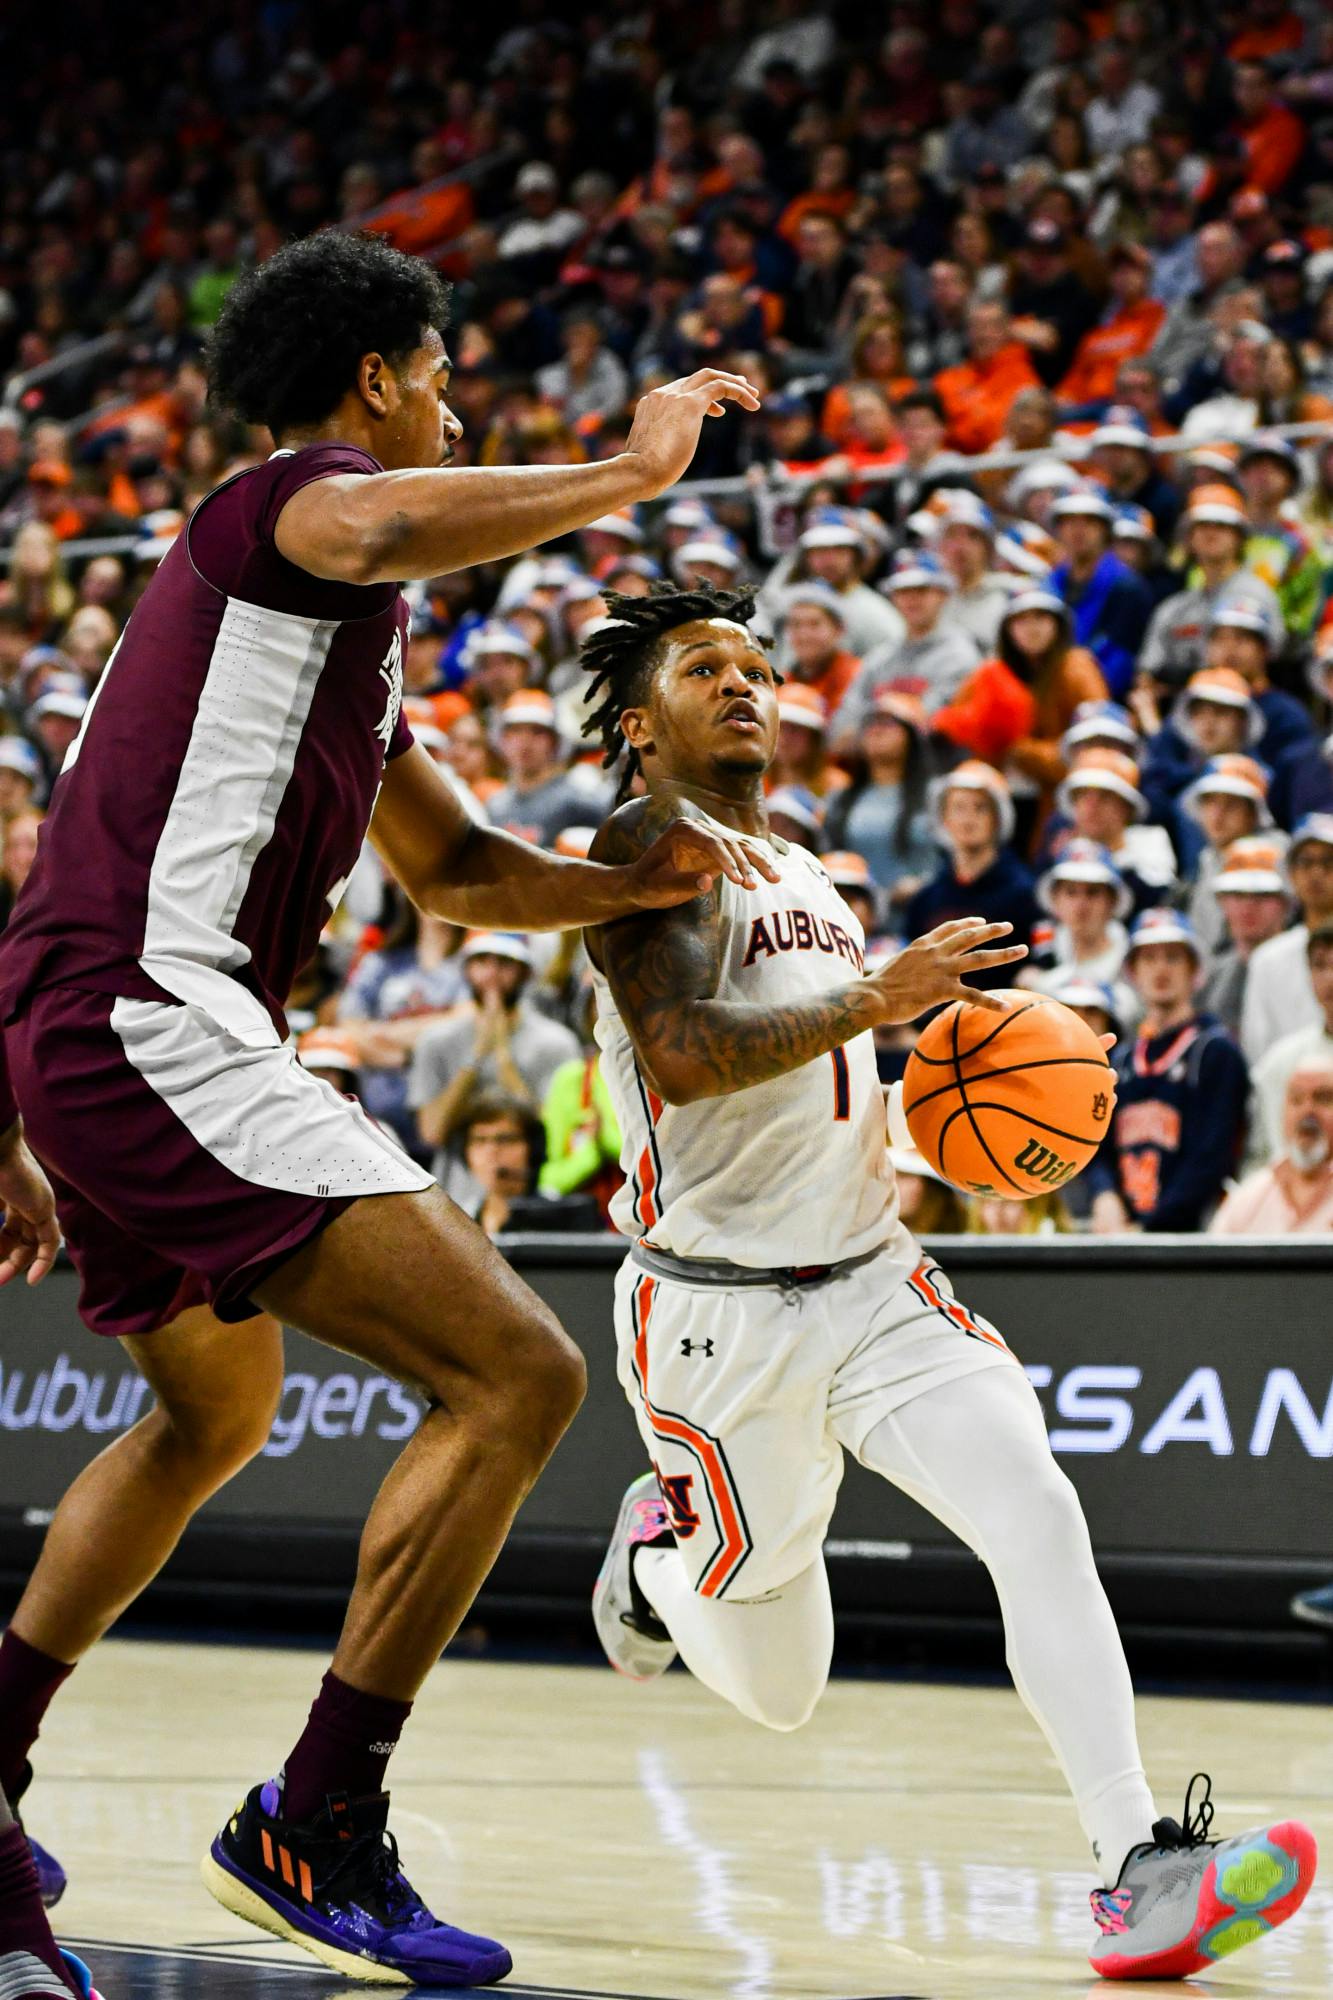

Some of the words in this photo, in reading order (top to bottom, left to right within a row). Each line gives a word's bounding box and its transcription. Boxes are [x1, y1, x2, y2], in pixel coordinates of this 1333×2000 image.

[830, 1044, 850, 1121] 1
[1014, 1137, 1077, 1185] Wil
[0, 1352, 151, 1433] ubur
[262, 1373, 421, 1457] gers
